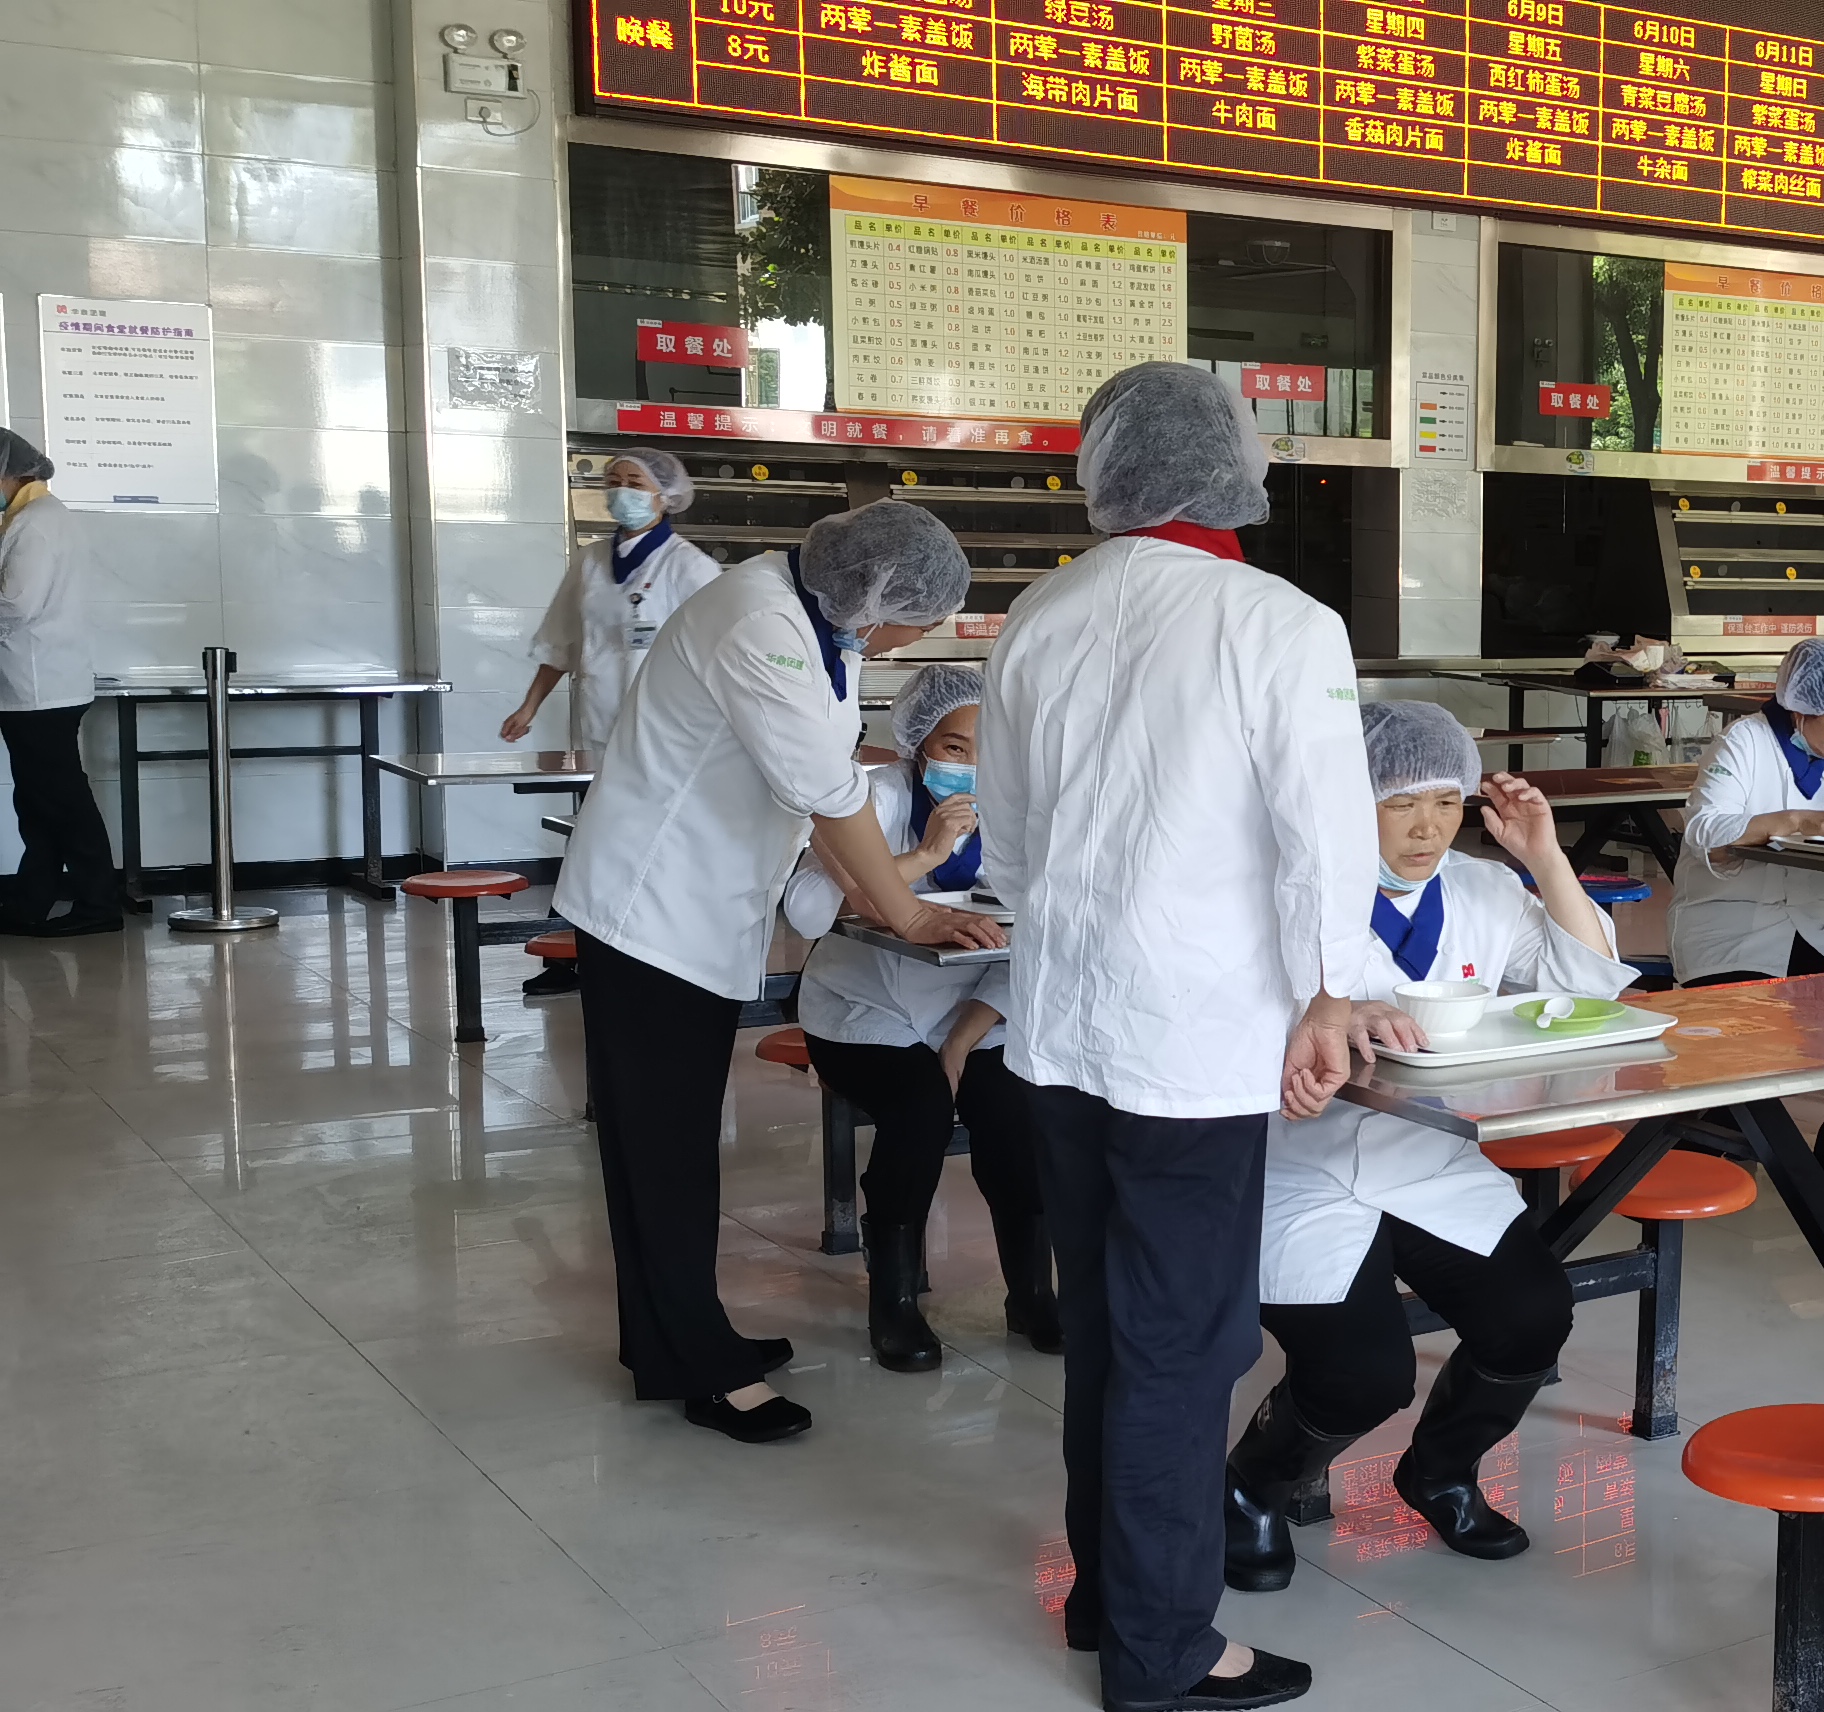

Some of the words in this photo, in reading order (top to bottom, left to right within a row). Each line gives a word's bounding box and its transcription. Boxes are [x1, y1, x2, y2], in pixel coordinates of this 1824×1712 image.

[1045, 0, 1113, 30] 绿豆汤
[1508, 0, 1563, 26] 6月9日
[820, 3, 973, 50] 两荤一素盖饭
[1366, 8, 1424, 40] 星期四
[617, 17, 673, 49] 晚餐
[1634, 21, 1694, 48] 6月10日
[1212, 24, 1275, 54] 野菌汤
[728, 35, 769, 62] 8元
[1508, 32, 1562, 61] 星期五
[1010, 31, 1149, 77] 两荤一素盖饭
[1756, 41, 1812, 67] 6月11日
[1356, 44, 1435, 78] 紫菜蛋汤
[1639, 52, 1690, 80] 星期六
[862, 51, 938, 86] 炸酱面
[1180, 57, 1307, 97] 两荤一素盖饭
[1489, 63, 1580, 99] 西红柿蛋汤
[1760, 72, 1807, 99] 星期日
[1022, 73, 1138, 112] 海带肉片面
[1336, 79, 1455, 117] 两荤一素盖饭
[1212, 100, 1275, 131] 牛肉面
[1479, 100, 1589, 135] 两荤一素盖饭
[1752, 104, 1815, 133] 紫菜蛋汤
[1345, 117, 1443, 151] 香菇肉片面
[1612, 118, 1714, 152] 两荤一素盖饭
[1506, 139, 1561, 165] 炸酱面
[1638, 156, 1688, 181] 牛杂面
[1742, 169, 1821, 198] 榨菜肉丝面
[912, 194, 1117, 231] 早餐价格表
[855, 220, 876, 231] 品名
[886, 224, 902, 233] 单价
[914, 226, 934, 237] 品名
[945, 229, 960, 239] 单价
[888, 243, 900, 251] 0.4
[946, 248, 958, 257] 0.8
[1003, 254, 1014, 262] 1.0
[1058, 259, 1068, 267] 1.0
[850, 259, 878, 270] 方馒头
[889, 262, 901, 270] 0.5
[1112, 263, 1122, 271] 1.2
[947, 267, 958, 276] 0.8
[1004, 272, 1014, 281] 1.0
[889, 281, 901, 290] 0.5
[1058, 277, 1068, 285] 1.0
[1112, 281, 1122, 289] 1.2
[909, 283, 937, 293] 小米粥
[947, 286, 959, 294] 0.8
[1004, 291, 1014, 299] 1.0
[1058, 295, 1068, 303] 1.0
[889, 300, 902, 308] 0.5
[947, 305, 959, 313] 0.8
[1004, 309, 1014, 317] 1.0
[1058, 313, 1068, 321] 1.0
[890, 319, 902, 327] 0.5
[948, 323, 960, 332] 0.8
[1058, 331, 1067, 339] 1.1
[1113, 334, 1122, 342] 1.3
[656, 333, 733, 358] 取餐处
[890, 337, 902, 346] 0.5
[948, 342, 960, 350] 0.8
[1005, 346, 1015, 354] 1.0
[1058, 349, 1069, 357] 1.2
[891, 357, 903, 365] 0.6
[1113, 352, 1122, 360] 1.5
[948, 360, 960, 368] 0.9
[1005, 364, 1015, 372] 1.0
[1059, 367, 1069, 375] 1.2
[891, 375, 903, 383] 0.7
[949, 378, 961, 388] 0.9
[1256, 374, 1312, 392] 取餐处
[1005, 382, 1016, 390] 1.0
[1060, 385, 1069, 393] 1.2
[891, 394, 903, 403] 0.7
[949, 397, 961, 406] 1.0
[1551, 393, 1600, 409] 取餐处
[1005, 400, 1016, 408] 1.0
[1059, 403, 1069, 411] 1.2
[1728, 623, 1777, 634] 保温台工作中
